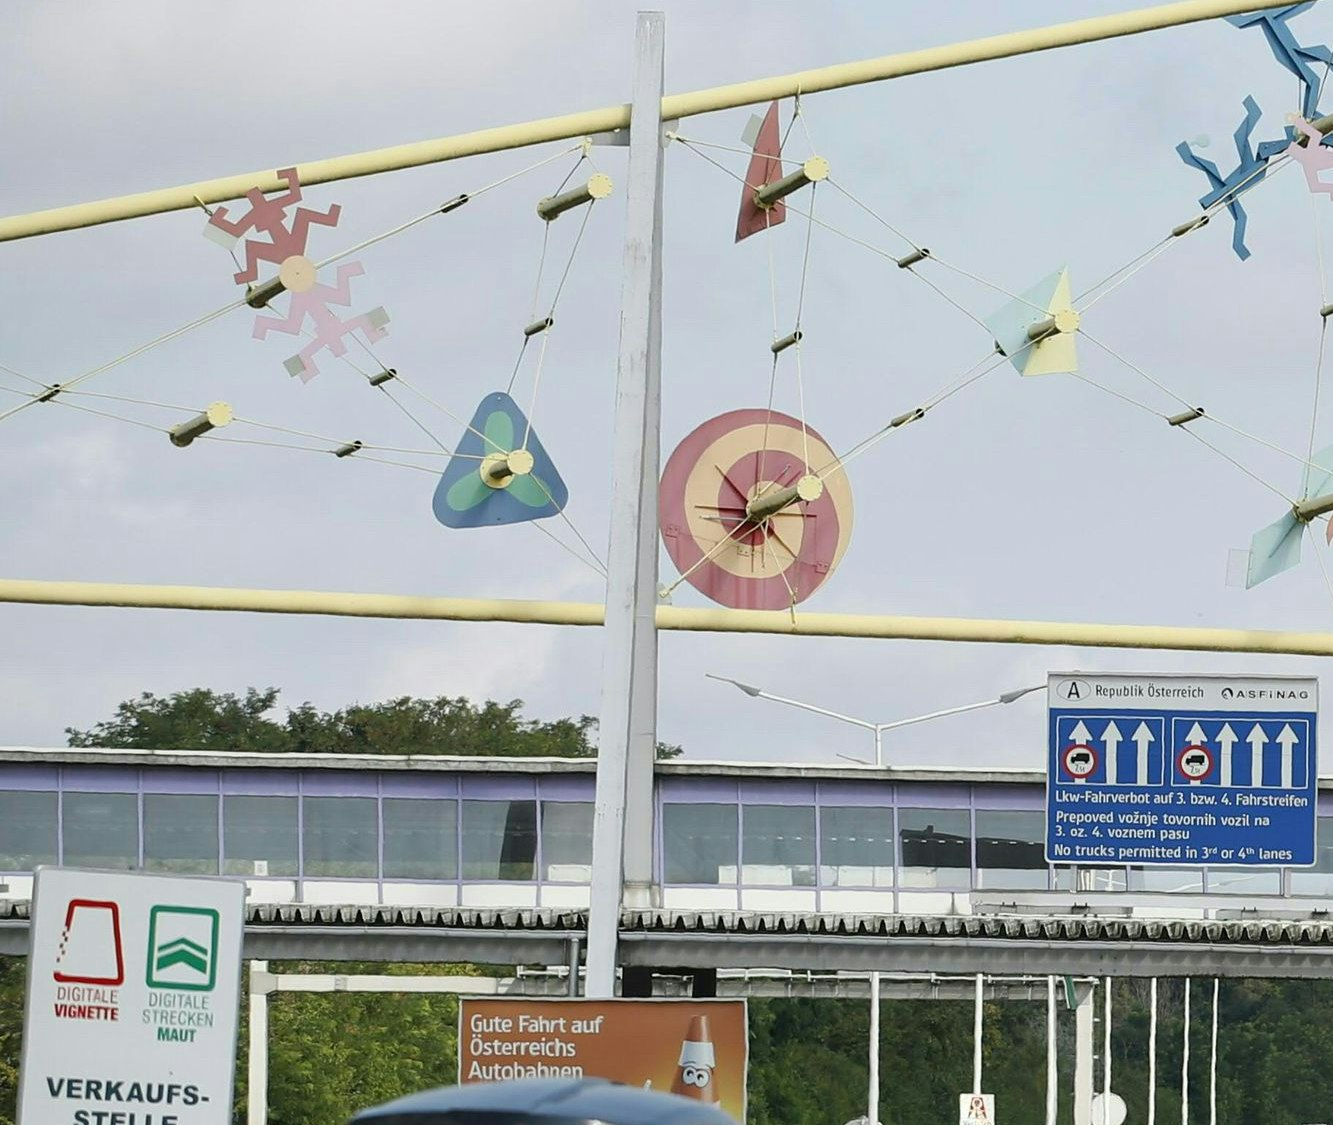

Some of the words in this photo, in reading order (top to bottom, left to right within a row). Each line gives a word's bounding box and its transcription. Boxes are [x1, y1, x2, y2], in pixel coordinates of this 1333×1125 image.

[1067, 682, 1080, 698] A
[1095, 684, 1144, 699] Republik
[1147, 683, 1204, 698] Österreich
[1056, 790, 1150, 804] Lkw-Fahrverbot
[1153, 792, 1174, 804] auf
[1176, 792, 1186, 805] 3.
[1190, 792, 1218, 805] bzw.
[1220, 793, 1232, 806] 4.
[1236, 793, 1308, 807] Fahrstreifen
[1056, 810, 1114, 825] Prepoved
[1118, 811, 1158, 827] vožnje
[1163, 813, 1216, 826] tovornih
[1221, 814, 1250, 826] vozil
[1254, 816, 1270, 826] na
[1055, 825, 1066, 836] 3.
[1070, 827, 1088, 837] oz.
[1091, 826, 1103, 837] 4.
[1107, 828, 1156, 839] voznem
[1159, 829, 1190, 842] pasu
[1054, 844, 1071, 856] No
[1075, 844, 1115, 856] trucks
[1118, 846, 1181, 860] permitted
[1185, 846, 1198, 858] in
[1201, 846, 1218, 859] 3rd
[1221, 848, 1234, 858] or
[1238, 847, 1255, 859] 4th
[1259, 848, 1293, 860] lanes
[57, 986, 119, 1005] DIGITALE
[148, 992, 210, 1010] DIGITALE
[54, 1003, 119, 1021] VIGNETTE
[142, 1009, 214, 1027] STRECKEN
[470, 1014, 513, 1033] Gute
[519, 1015, 566, 1033] Fahrt
[571, 1016, 604, 1034] auf
[157, 1027, 197, 1043] MAUT
[470, 1034, 576, 1057] Österreichs
[468, 1061, 583, 1080] Autobahnen
[46, 1077, 210, 1106] VERKAUFS-
